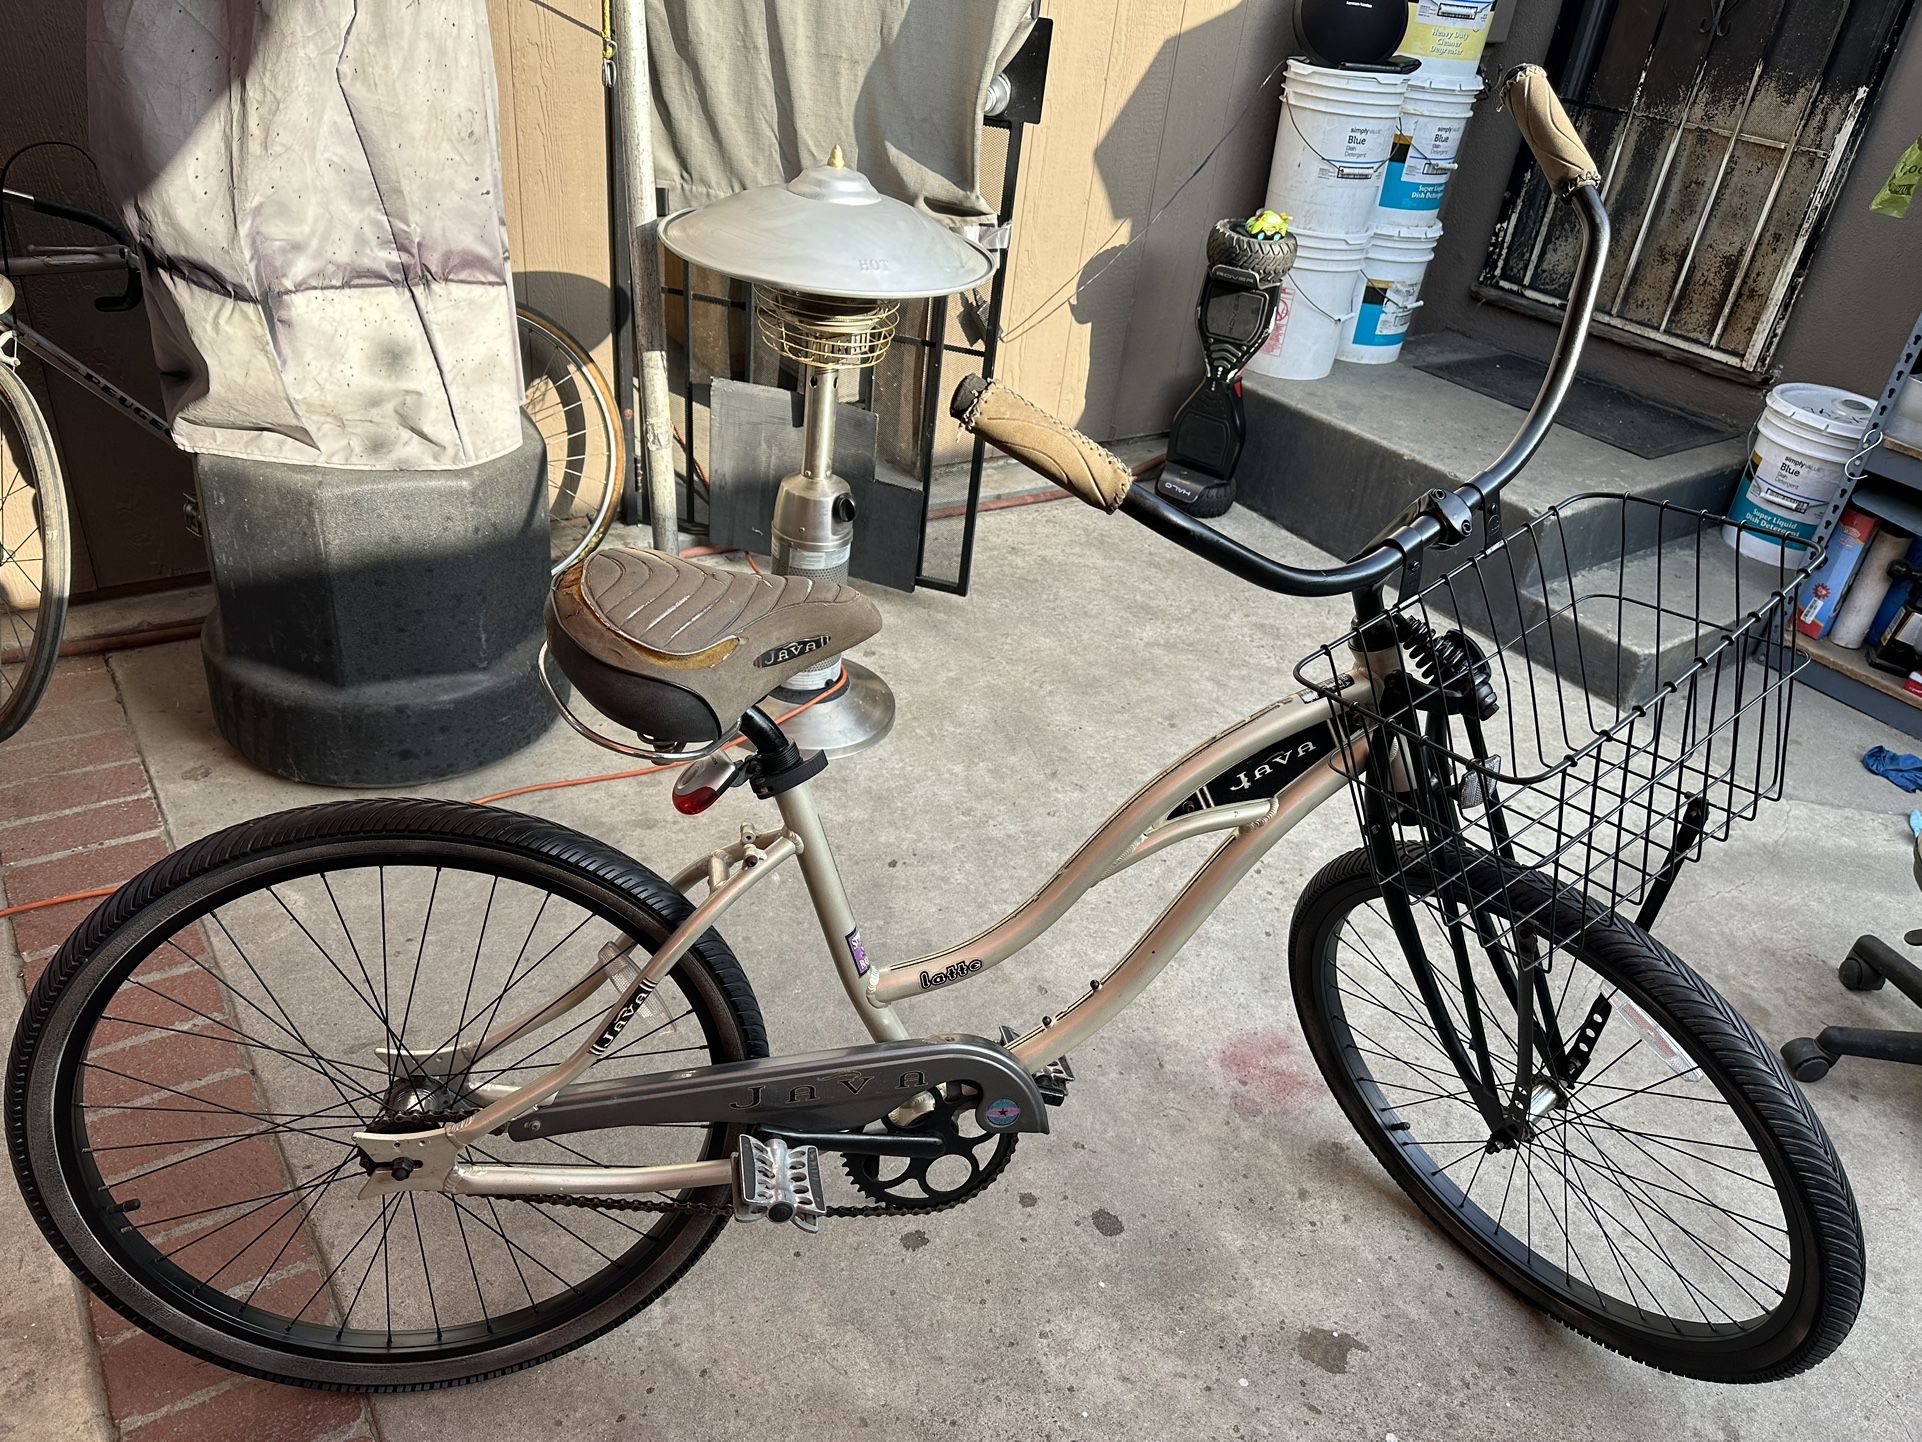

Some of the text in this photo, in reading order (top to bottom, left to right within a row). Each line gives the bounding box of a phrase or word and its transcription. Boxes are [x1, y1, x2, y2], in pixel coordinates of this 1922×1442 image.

[1432, 28, 1470, 42] Heavy Duty
[1437, 38, 1463, 48] Cleaner
[1430, 45, 1464, 56] Degreaser
[1347, 135, 1367, 145] Blue
[1434, 134, 1449, 143] Blue
[1411, 191, 1426, 199] Dish
[1418, 184, 1434, 194] Super
[859, 258, 889, 271] HOT
[1216, 271, 1254, 284] ROVER
[1779, 462, 1800, 477] Blue
[1164, 482, 1191, 497] HALO
[1745, 512, 1760, 524] Dish
[1753, 508, 1798, 531] Super Liquid
[920, 959, 982, 989] latte
